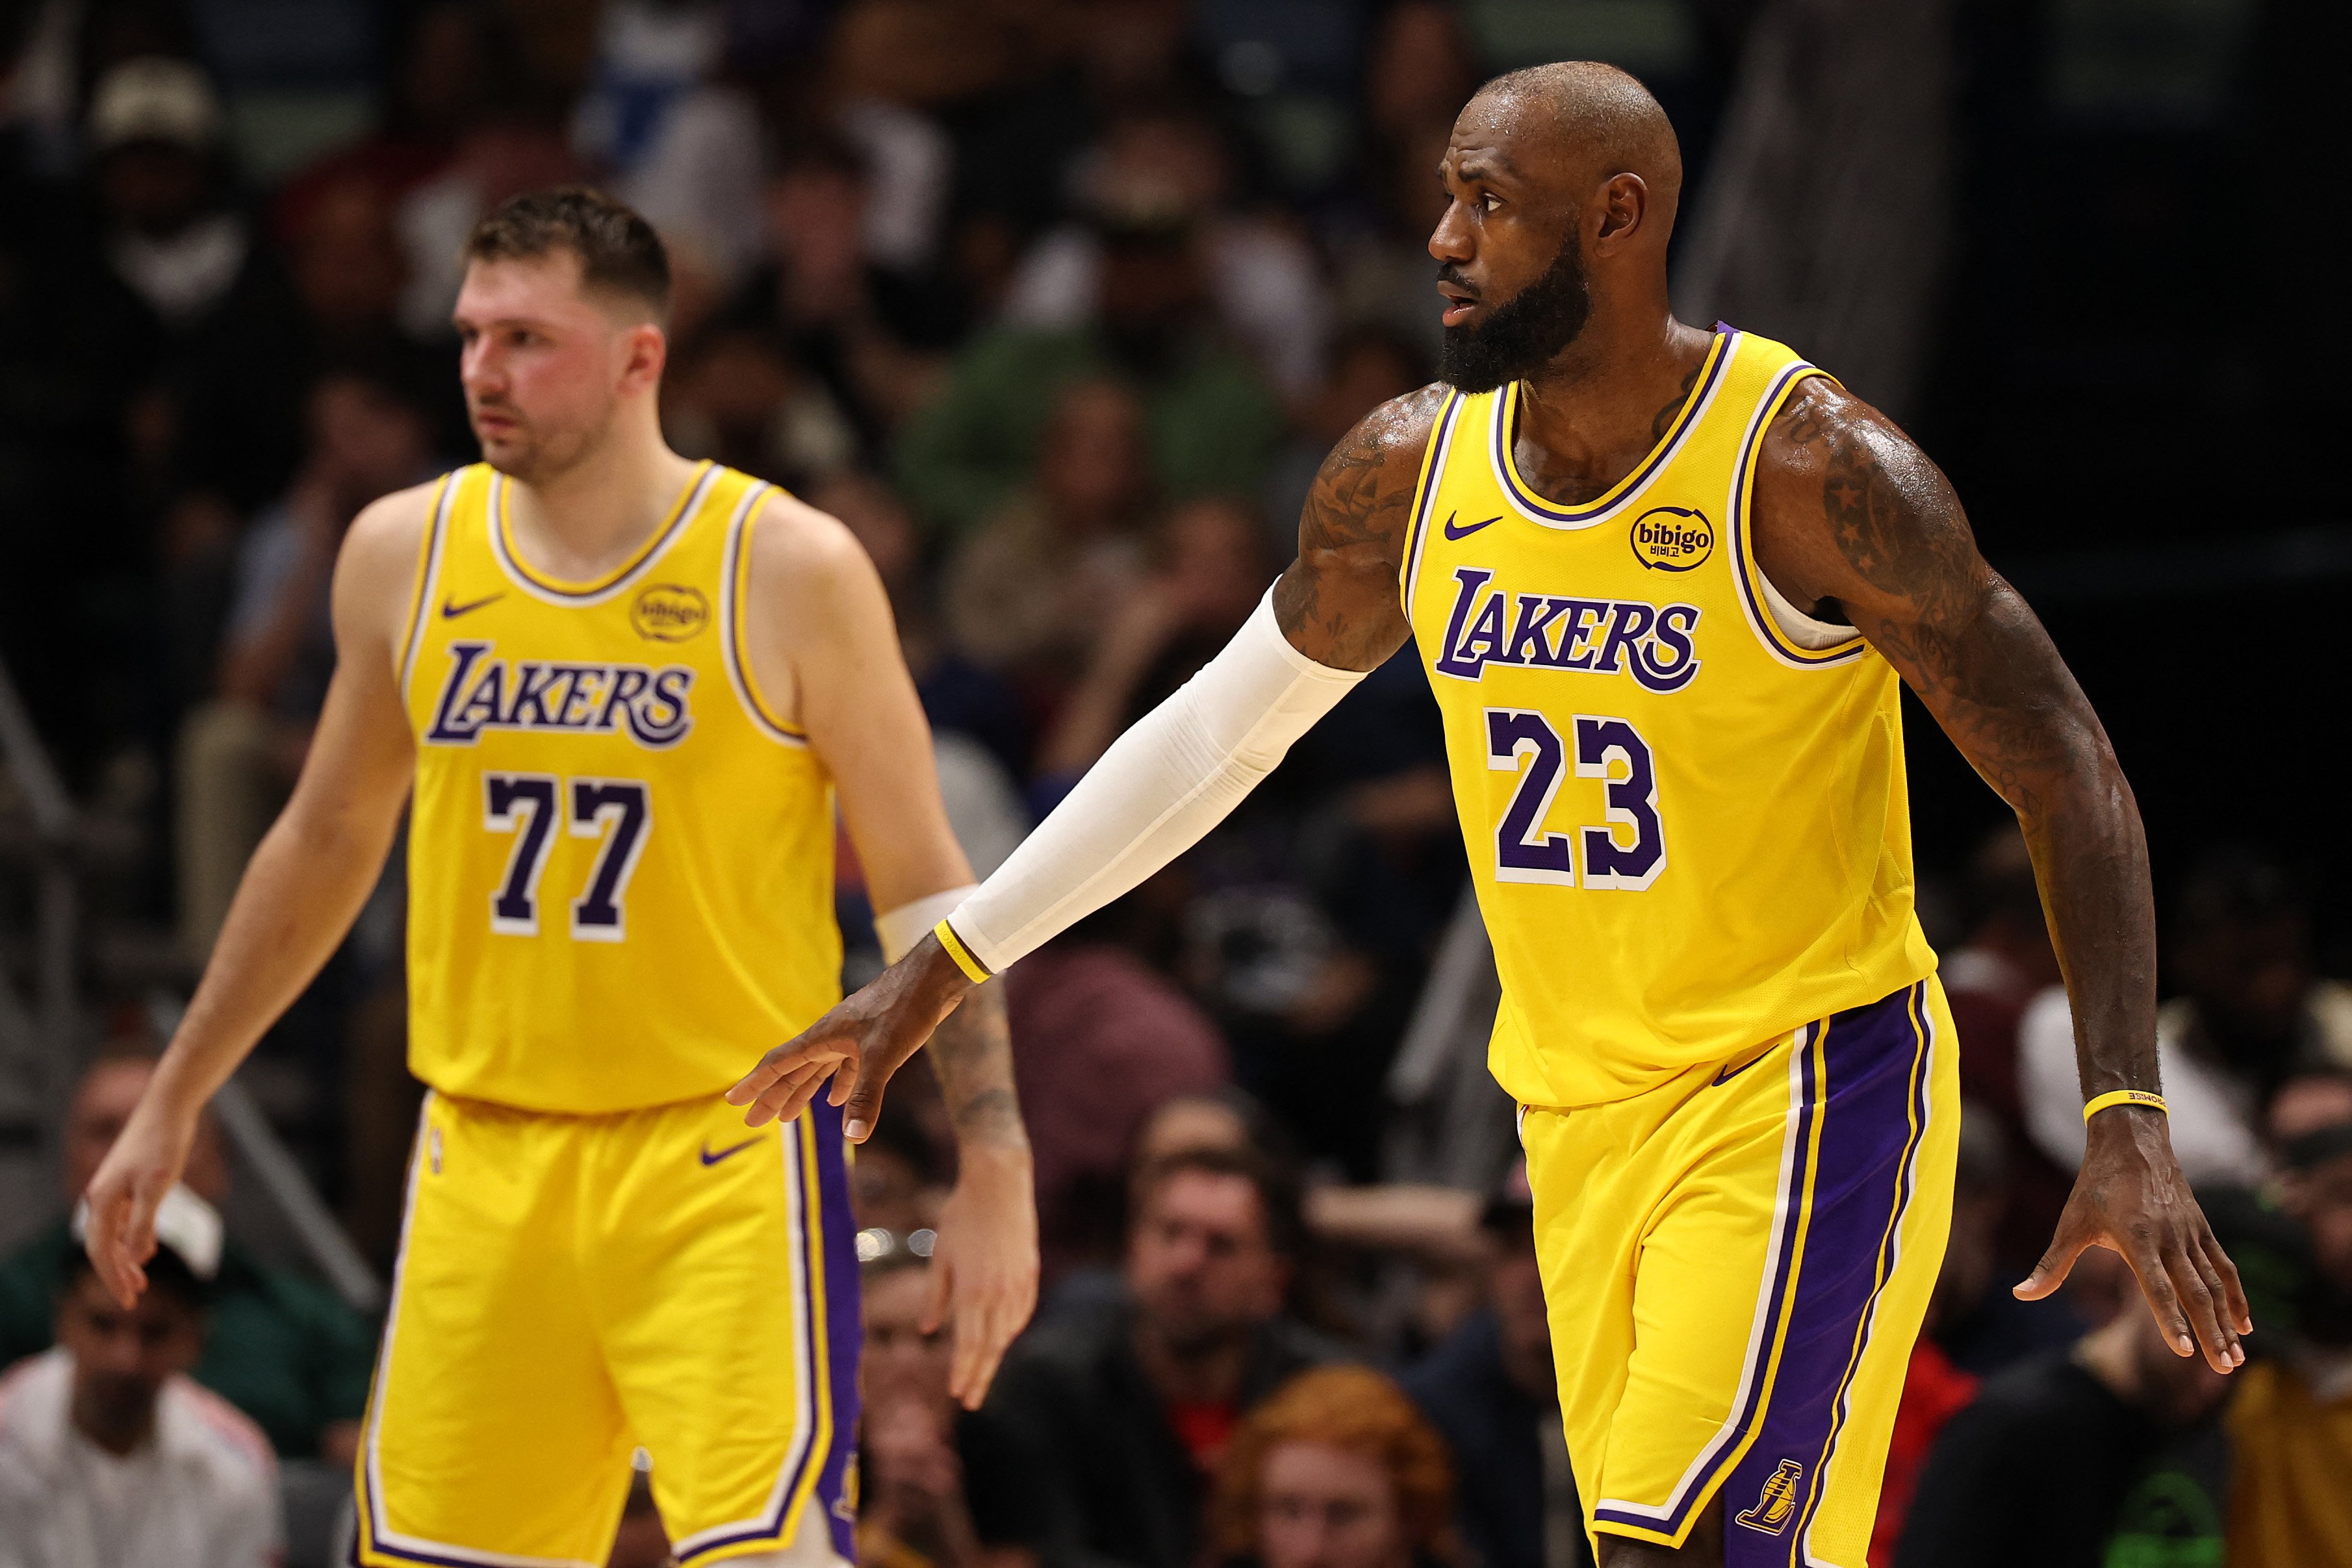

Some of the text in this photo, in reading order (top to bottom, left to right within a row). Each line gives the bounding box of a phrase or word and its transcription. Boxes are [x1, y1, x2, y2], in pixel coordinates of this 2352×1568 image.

[1639, 522, 1709, 554] bibigo
[1650, 545, 1680, 557] 비비고
[1435, 565, 1702, 694] LAKERS
[424, 640, 695, 750] LAKERS
[482, 771, 652, 942] 77
[1483, 707, 1667, 891] 23
